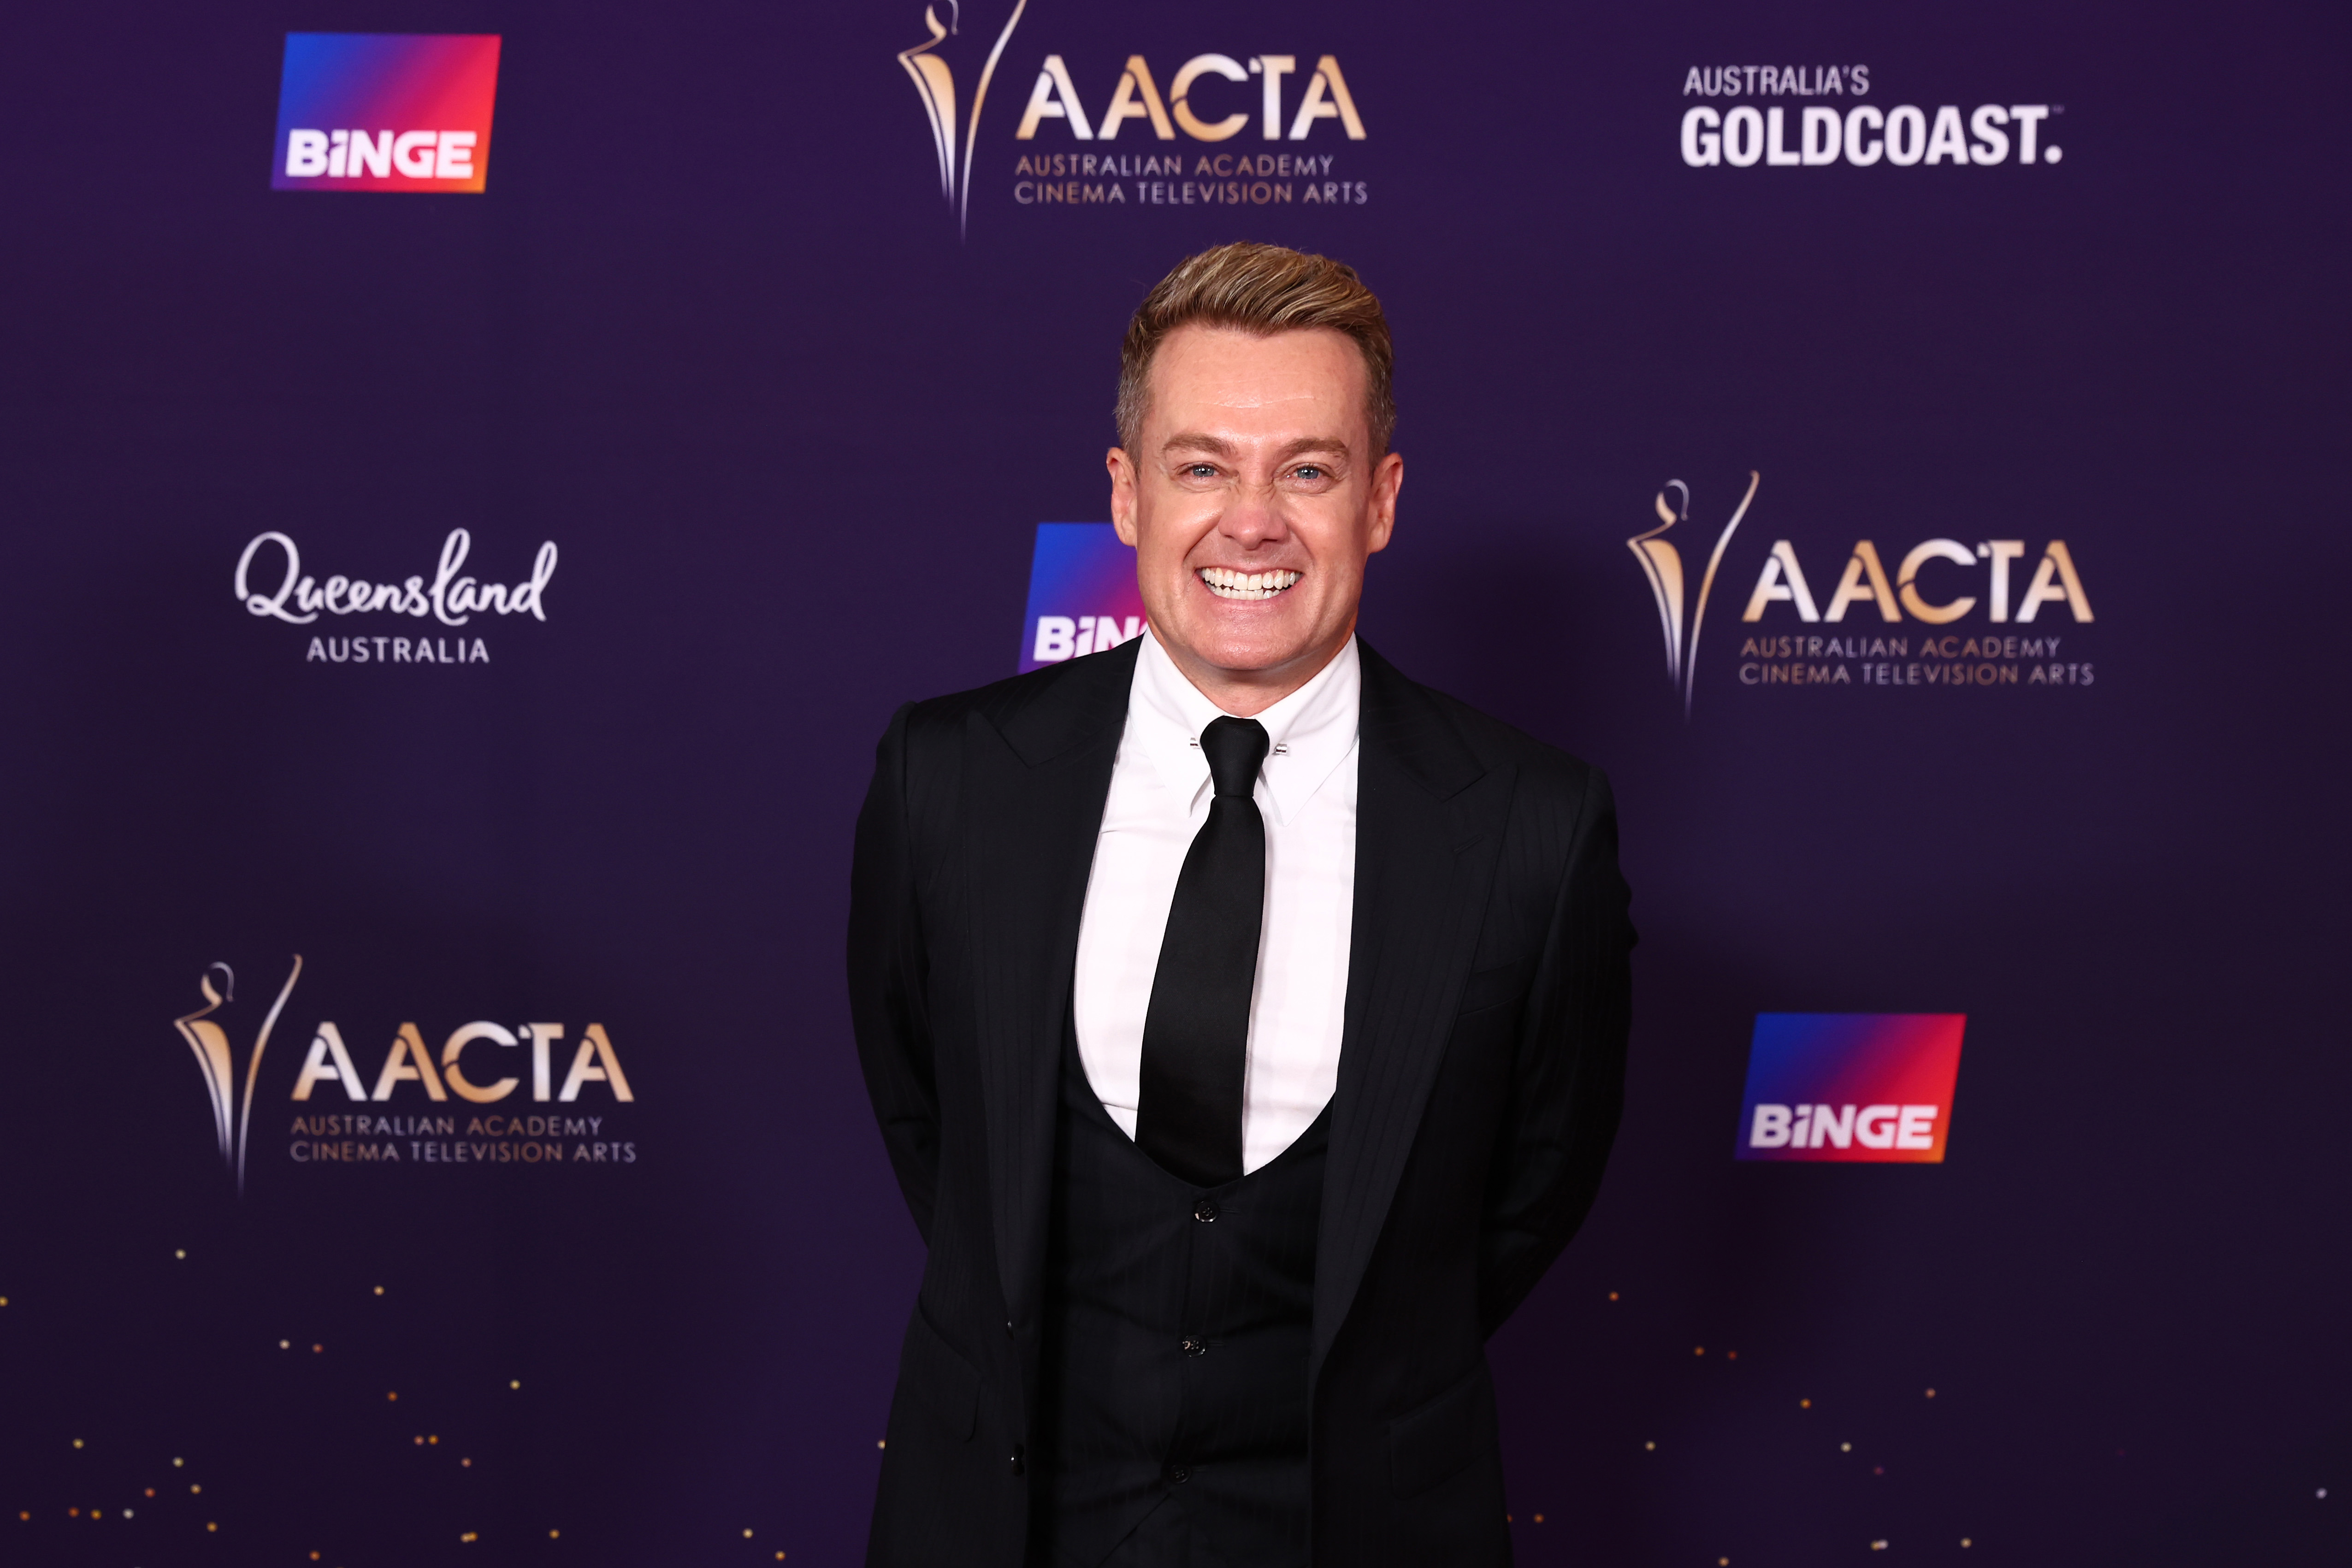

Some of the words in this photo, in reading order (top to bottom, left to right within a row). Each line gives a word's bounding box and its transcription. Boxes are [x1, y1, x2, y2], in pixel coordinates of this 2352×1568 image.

[1683, 65, 1870, 96] AUSTRALIA'S
[1016, 53, 1367, 142] AACTA
[1681, 105, 2062, 166] GOLDCOAST.
[1015, 154, 1182, 177] AUSTRALIAN
[1195, 154, 1334, 176] ACADEMY
[1014, 182, 1125, 204] CINEMA
[1137, 181, 1292, 205] TELEVISION
[1303, 181, 1368, 205] ARTS
[235, 527, 558, 627] Queensland
[1743, 538, 2094, 624] AACTA
[306, 636, 490, 664] AUSTRALIA
[1740, 636, 1908, 659] AUSTRALIAN
[1920, 636, 2061, 658] ACADEMY
[1739, 663, 1850, 685] CINEMA
[1862, 663, 2018, 686] TELEVISION
[2029, 663, 2095, 686] ARTS
[291, 1021, 634, 1104] AACTA
[291, 1115, 455, 1136] AUSTRALIAN
[467, 1116, 603, 1136] ACADEMY
[290, 1141, 400, 1162] CINEMA
[410, 1141, 563, 1163] TELEVISION
[573, 1141, 637, 1164] ARTS
